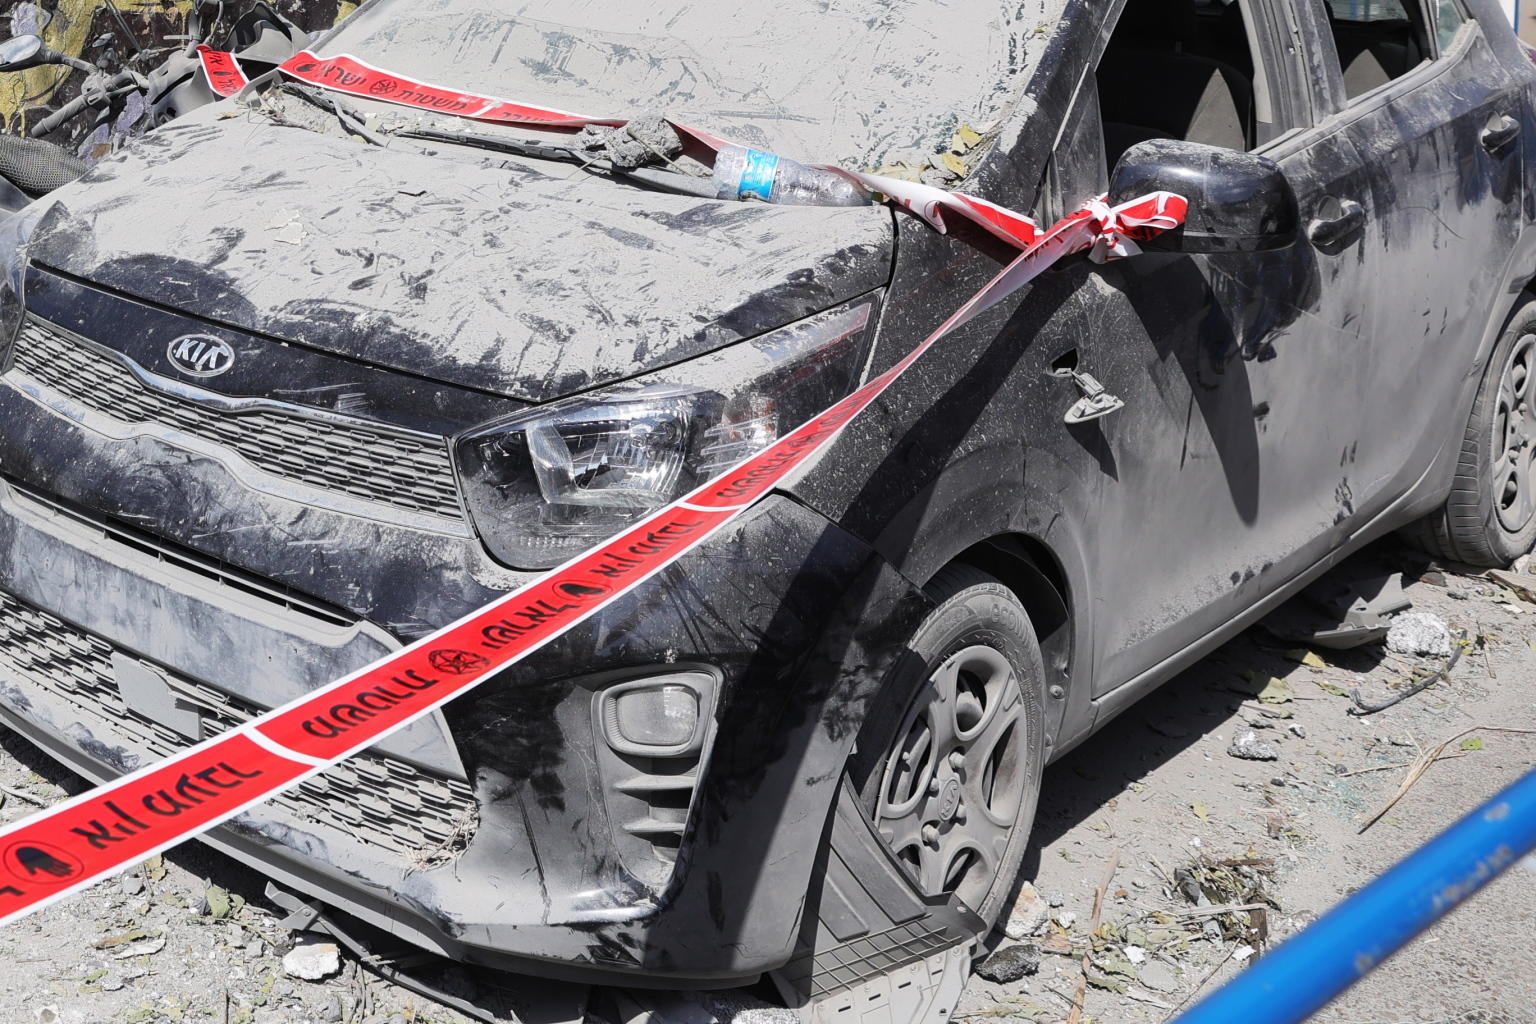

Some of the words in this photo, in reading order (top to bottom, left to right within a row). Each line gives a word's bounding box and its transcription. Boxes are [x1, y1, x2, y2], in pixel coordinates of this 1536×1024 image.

[394, 88, 468, 112] משטרת
[174, 338, 228, 370] KIA
[70, 799, 152, 850] אין
[141, 760, 264, 818] מעבר
[301, 667, 440, 740] משטרת
[481, 598, 581, 650] ישראל
[589, 555, 636, 580] אין
[627, 518, 705, 558] מעבר
